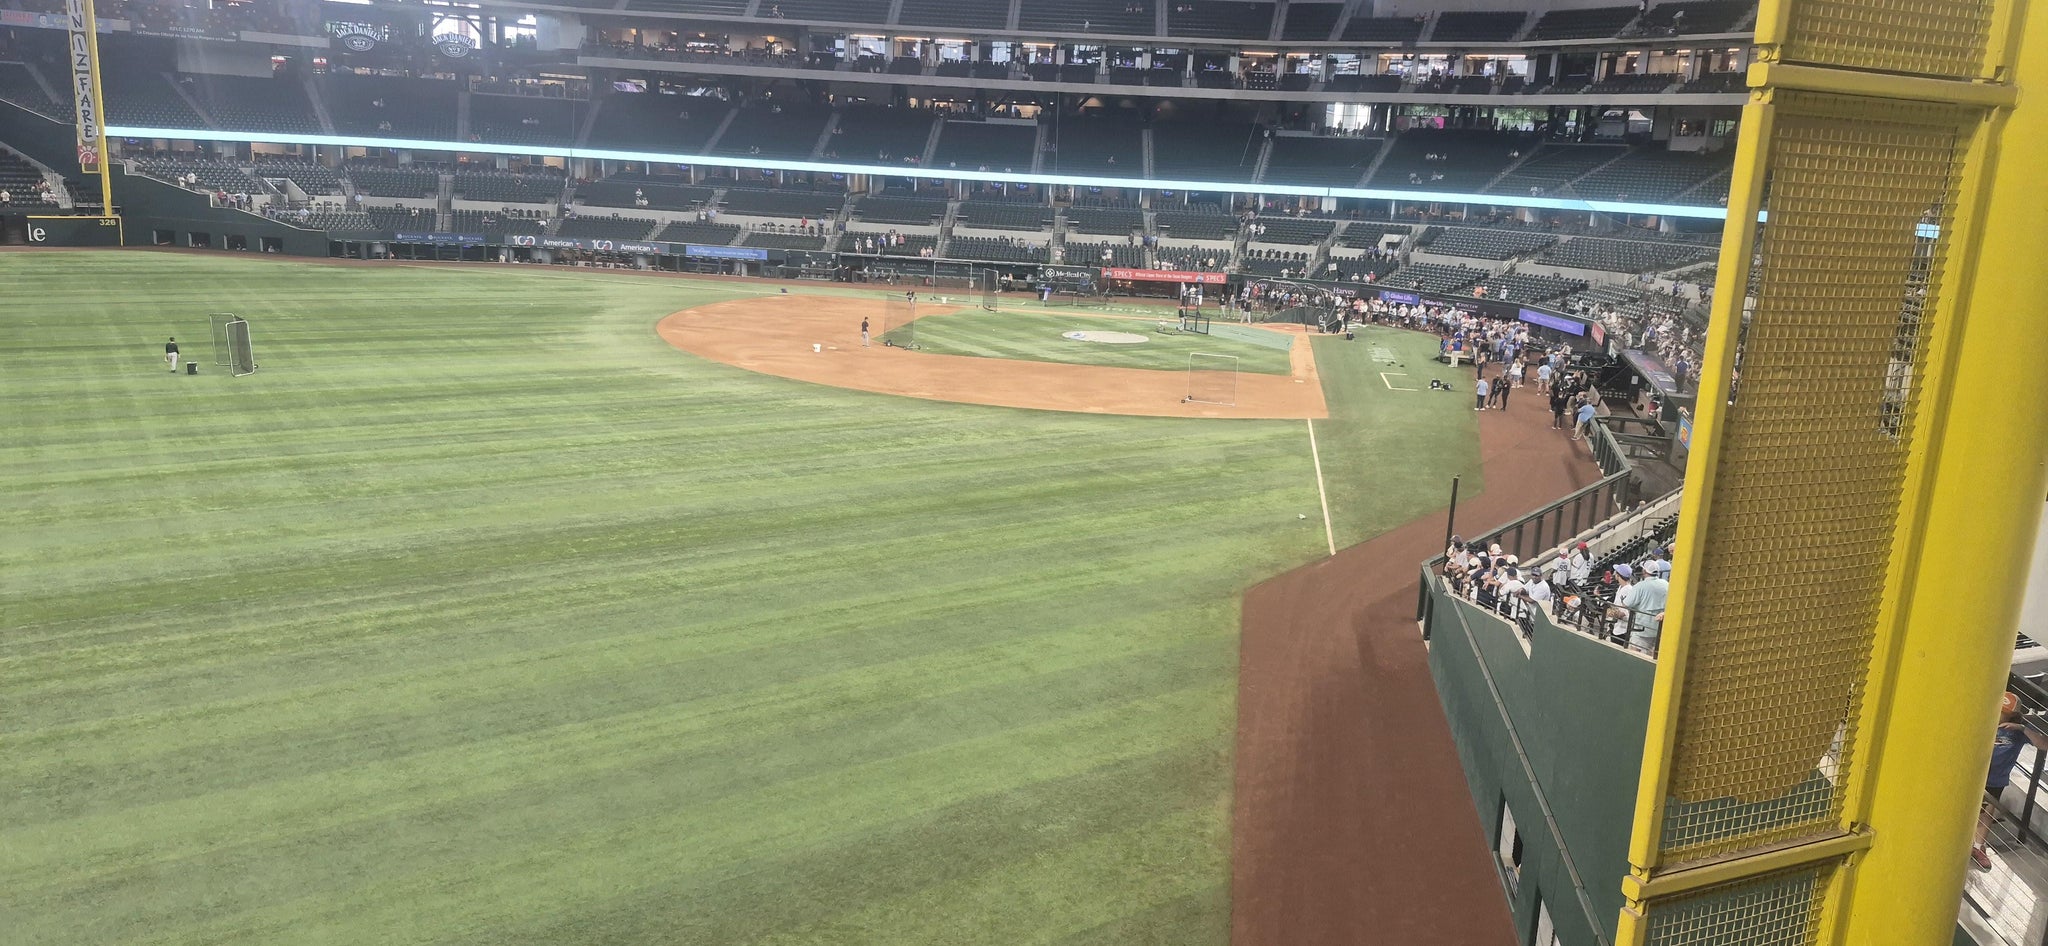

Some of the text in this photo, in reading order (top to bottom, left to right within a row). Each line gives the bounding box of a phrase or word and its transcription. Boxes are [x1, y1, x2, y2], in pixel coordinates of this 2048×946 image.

[336, 26, 353, 39] JACK
[431, 35, 449, 45] JACK
[78, 77, 93, 139] FARE
[543, 239, 574, 247] American
[620, 243, 651, 251] American
[1055, 270, 1091, 280] Medical City
[1114, 270, 1132, 278] SPEC'S
[1333, 287, 1356, 296] Harvey
